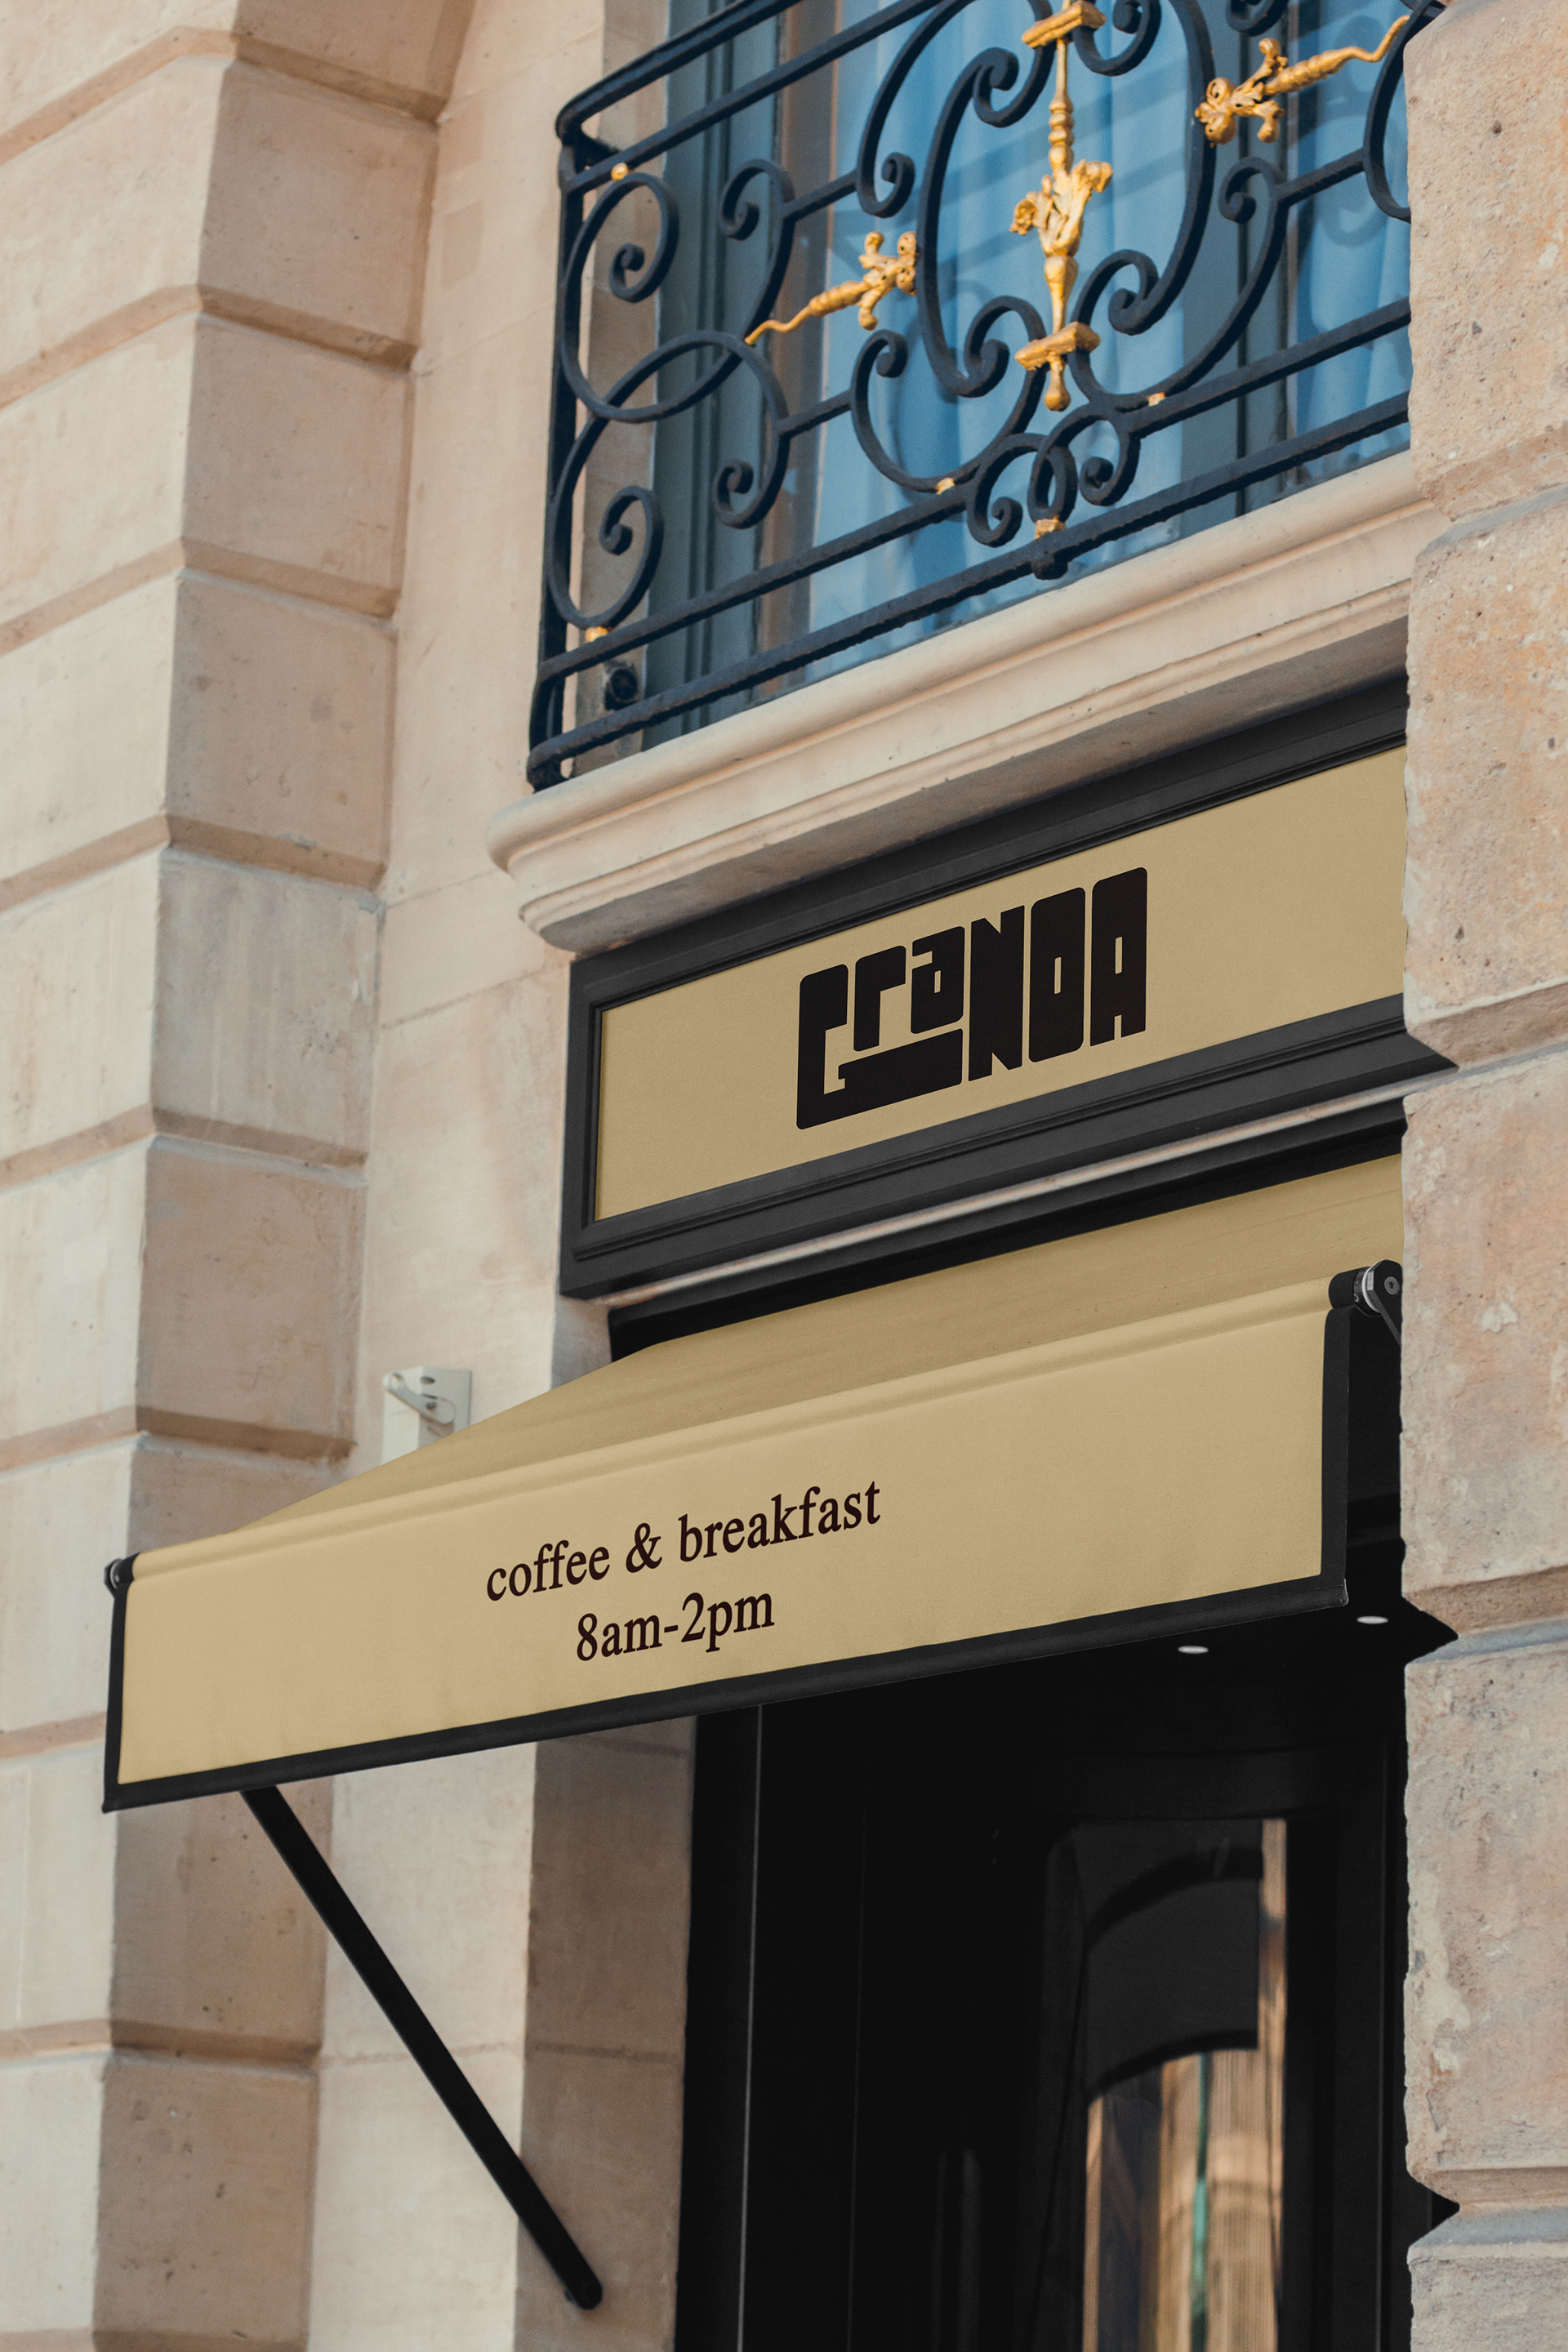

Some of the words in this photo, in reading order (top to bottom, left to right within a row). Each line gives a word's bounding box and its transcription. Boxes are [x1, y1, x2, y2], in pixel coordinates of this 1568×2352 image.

[486, 1539, 611, 1601] coffee
[625, 1522, 663, 1574] &
[678, 1481, 881, 1562] breakfast
[577, 1592, 775, 1662] 8am-2pm
